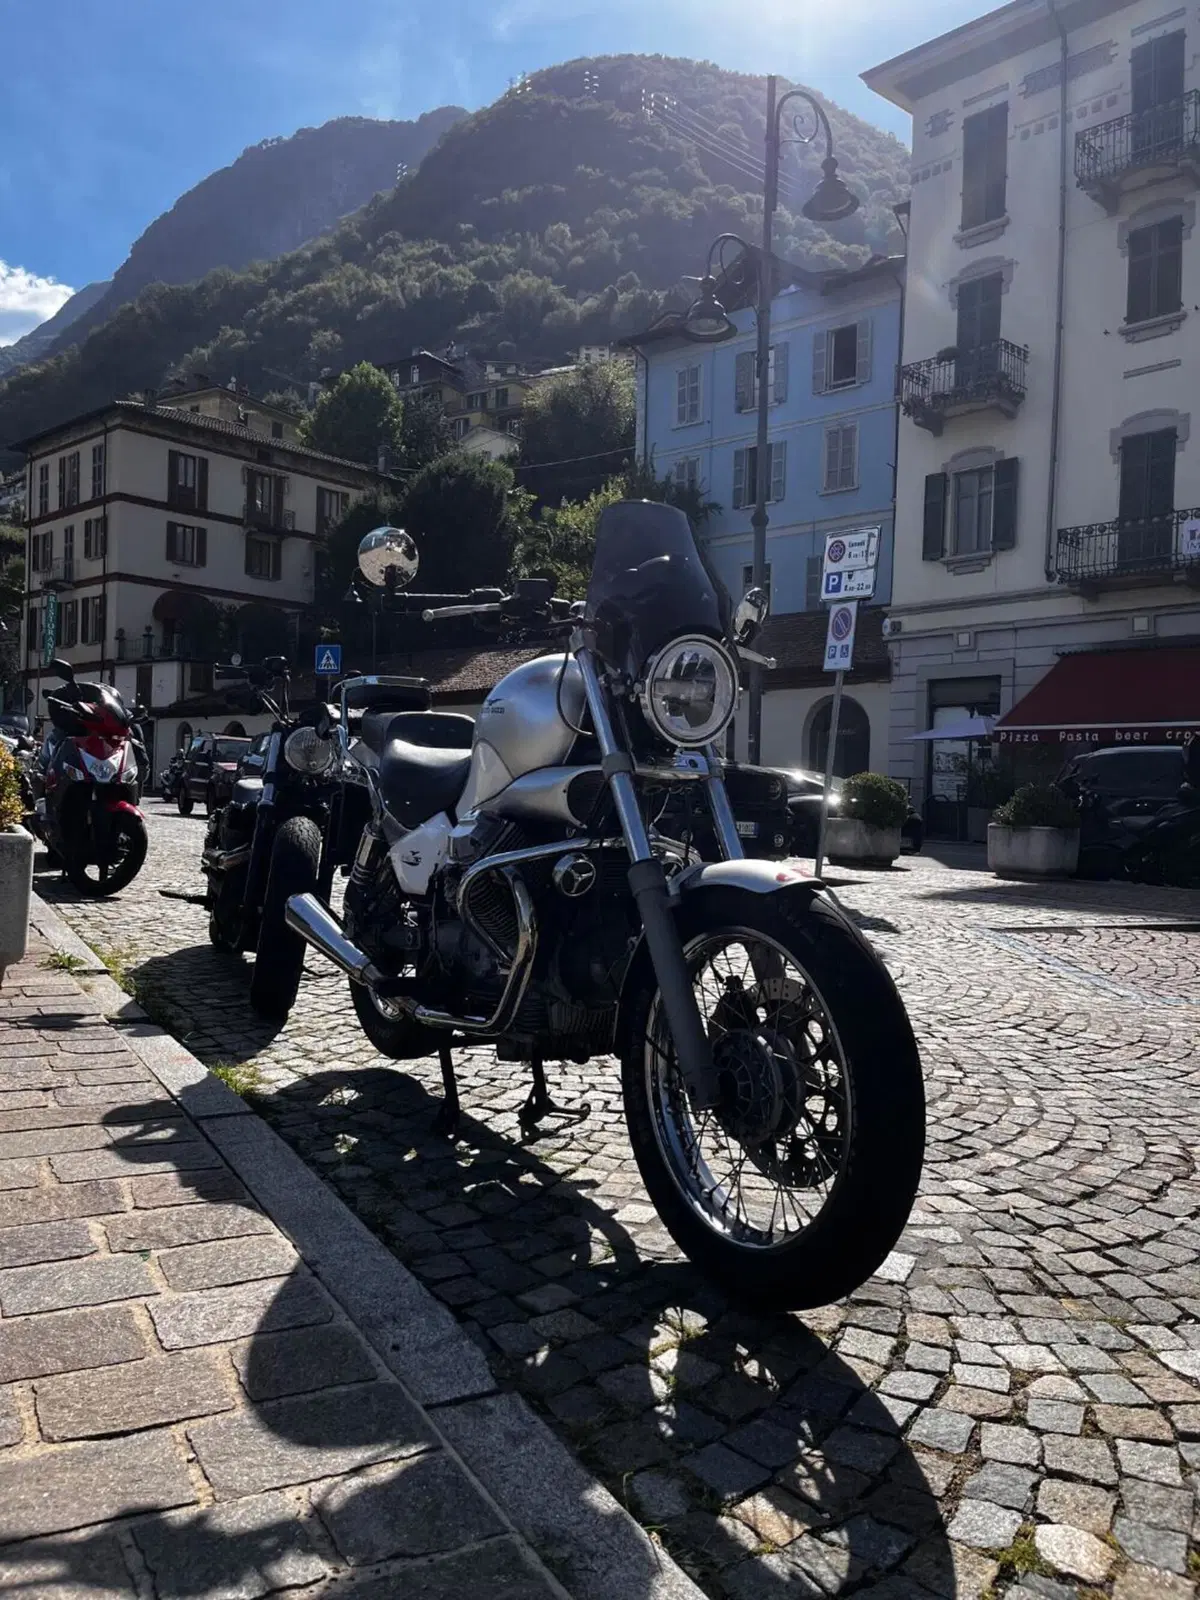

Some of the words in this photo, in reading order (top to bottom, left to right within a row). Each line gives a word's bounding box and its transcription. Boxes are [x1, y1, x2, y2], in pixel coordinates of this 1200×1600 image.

[828, 575, 839, 591] P
[1059, 731, 1099, 742] Pasta
[1115, 730, 1149, 740] beer
